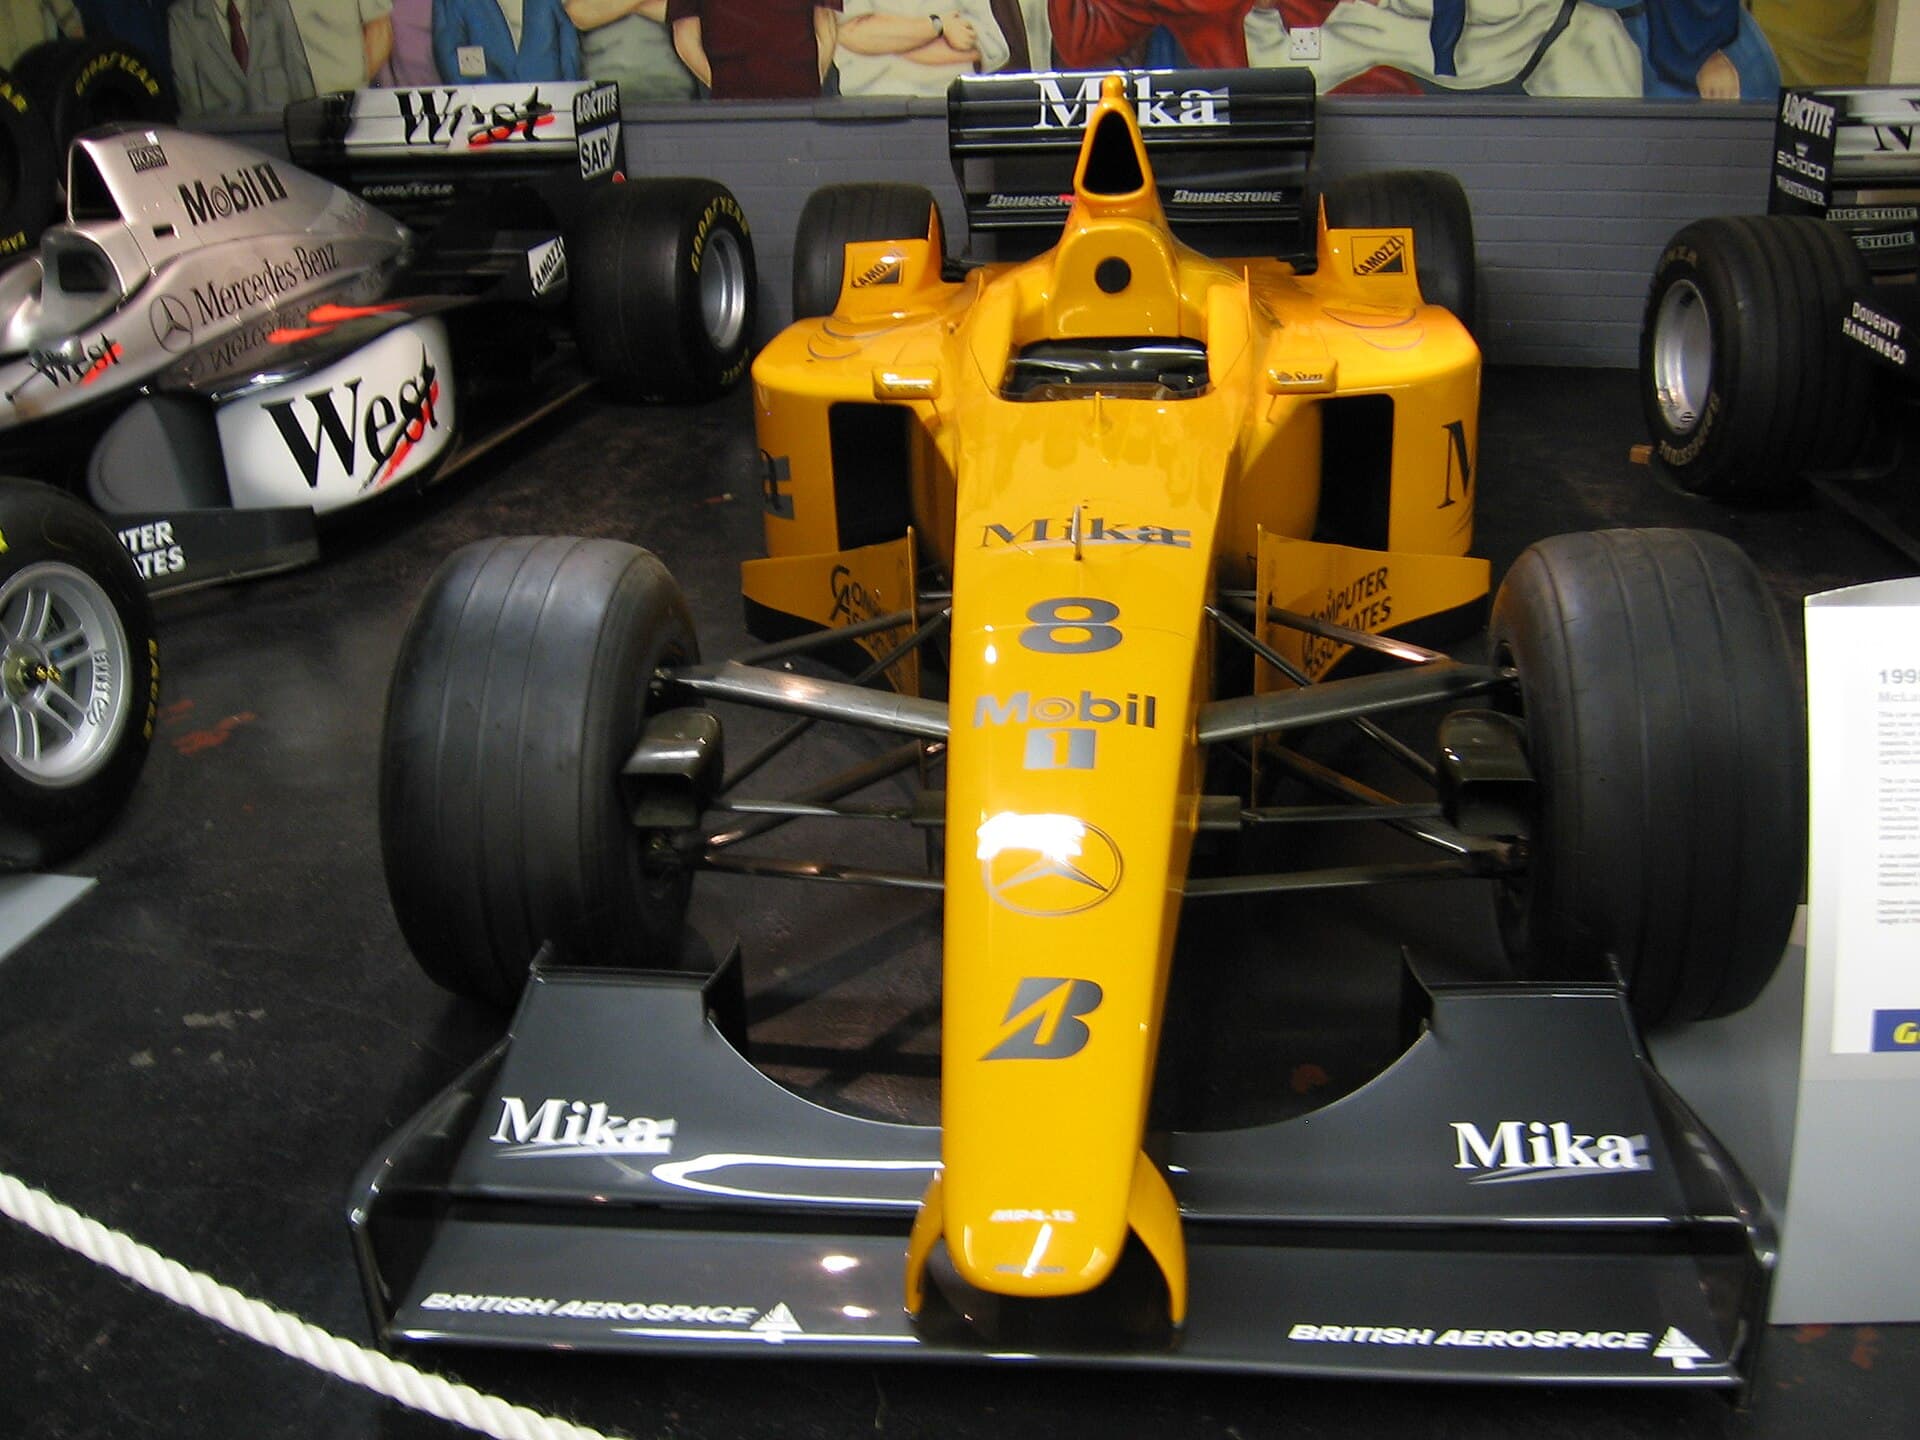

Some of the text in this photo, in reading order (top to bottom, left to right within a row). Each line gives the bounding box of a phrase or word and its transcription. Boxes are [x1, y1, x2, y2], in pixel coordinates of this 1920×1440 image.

[1033, 76, 1224, 129] Mka
[177, 168, 264, 226] Mobil
[1171, 189, 1283, 204] BRIDGESTONE
[1353, 235, 1404, 276] CAMOZZI
[191, 243, 340, 326] Mercedes-Benz
[1852, 301, 1901, 339] DOUGHTY
[260, 344, 439, 490] West
[1019, 597, 1123, 654] 8
[1878, 668, 1920, 685] 199
[973, 691, 1155, 728] Mobil
[489, 1096, 670, 1148] Mika
[1448, 1120, 1641, 1170] Mika
[420, 1293, 759, 1324] BRITISH AEROSPACE
[1288, 1323, 1652, 1350] BRITISH AEROSPACE
